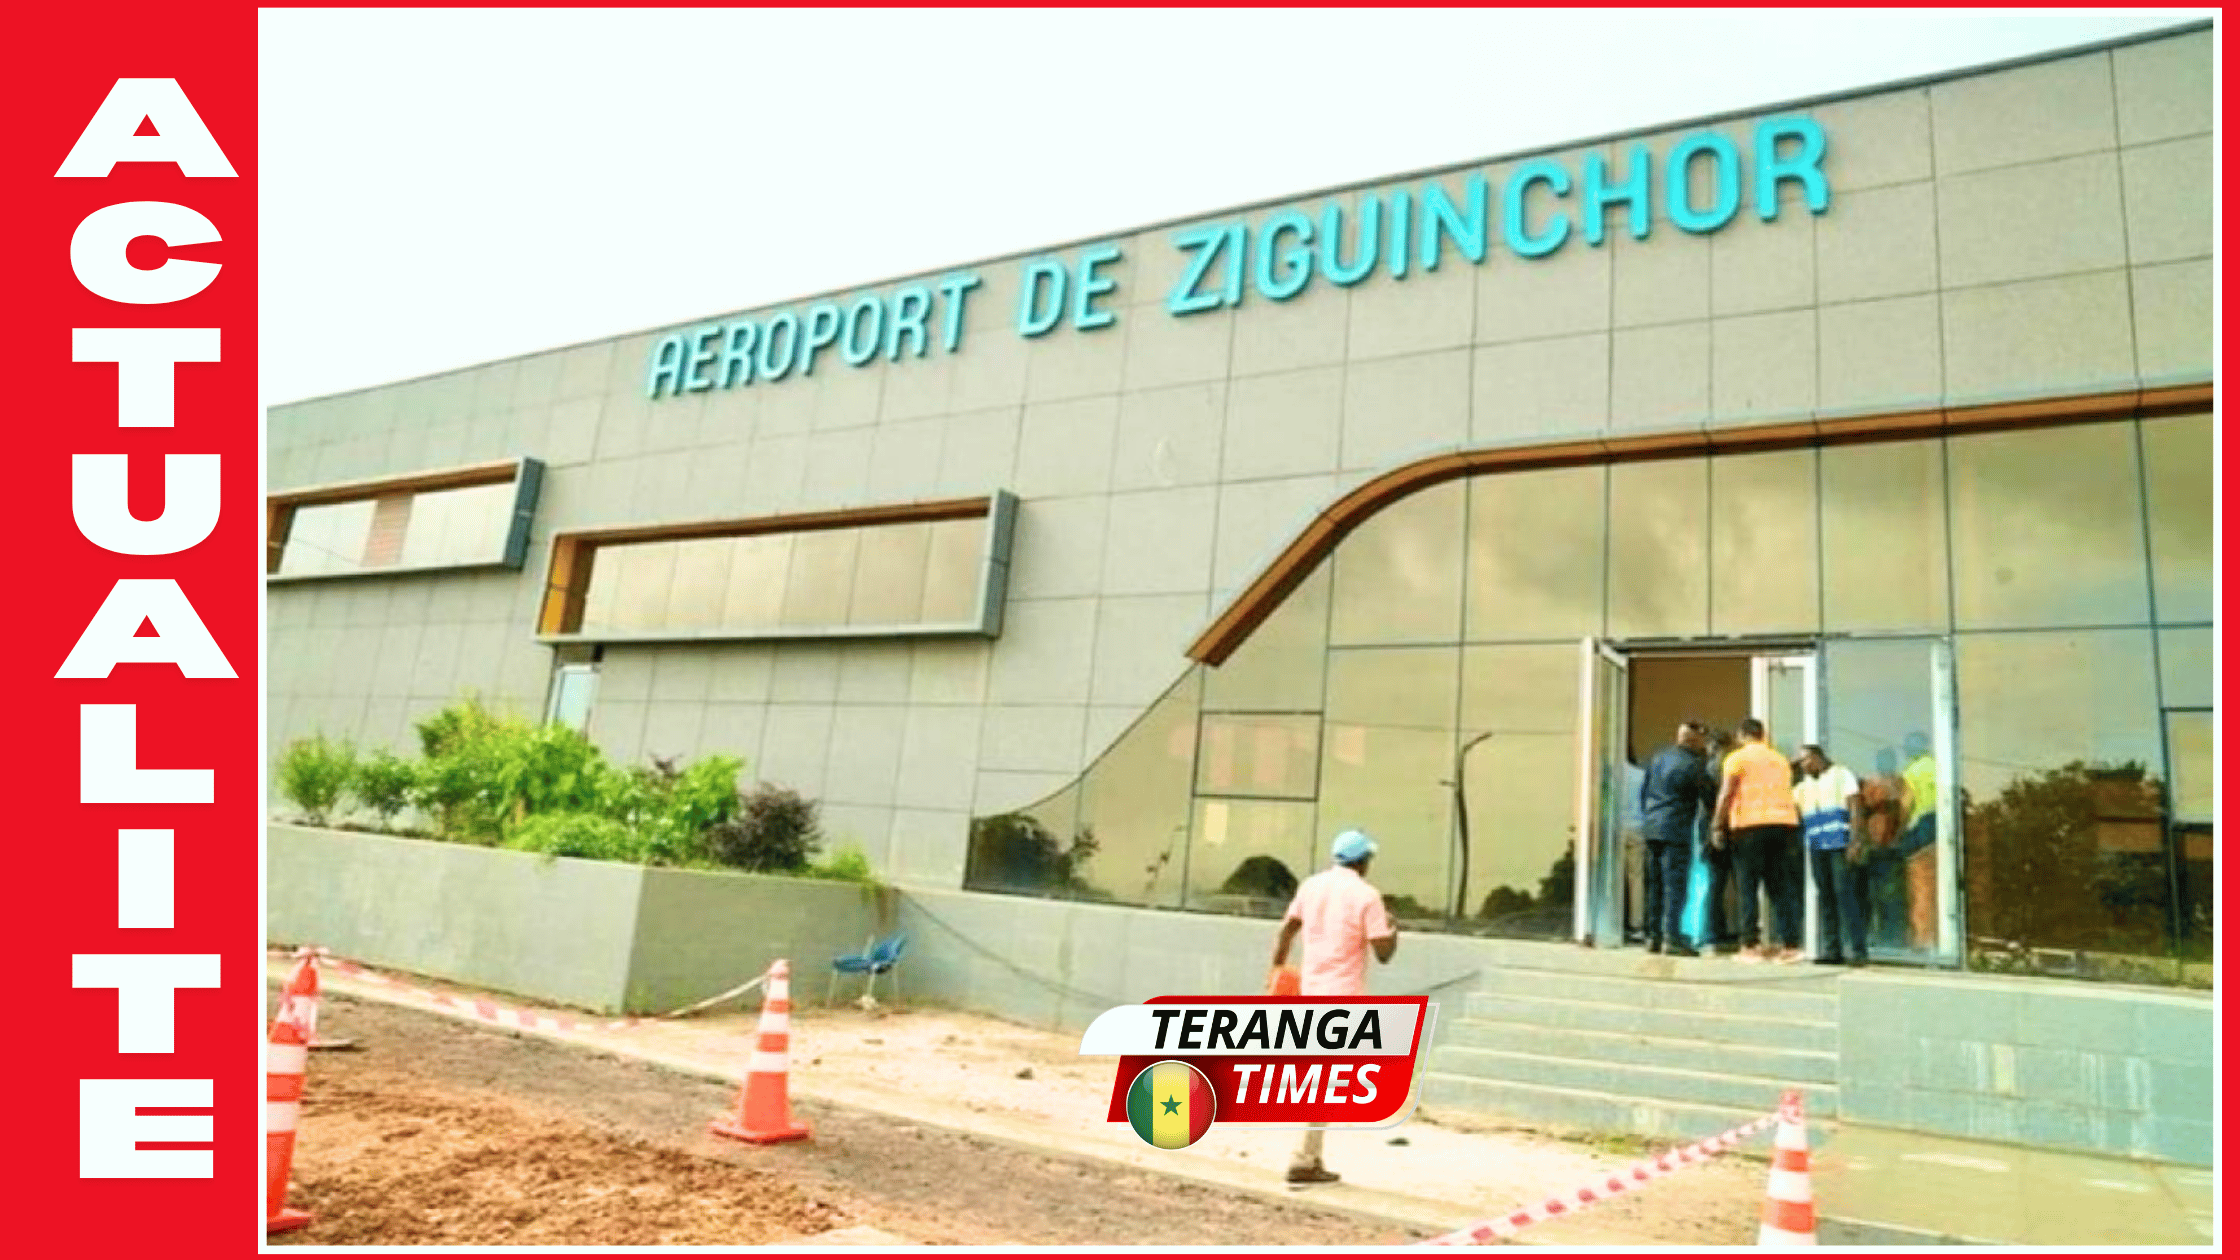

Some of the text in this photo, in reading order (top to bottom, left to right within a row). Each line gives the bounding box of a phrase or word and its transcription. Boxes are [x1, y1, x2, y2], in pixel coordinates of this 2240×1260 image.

[647, 115, 1829, 398] AEROPORT DE ZIGUINCHOR
